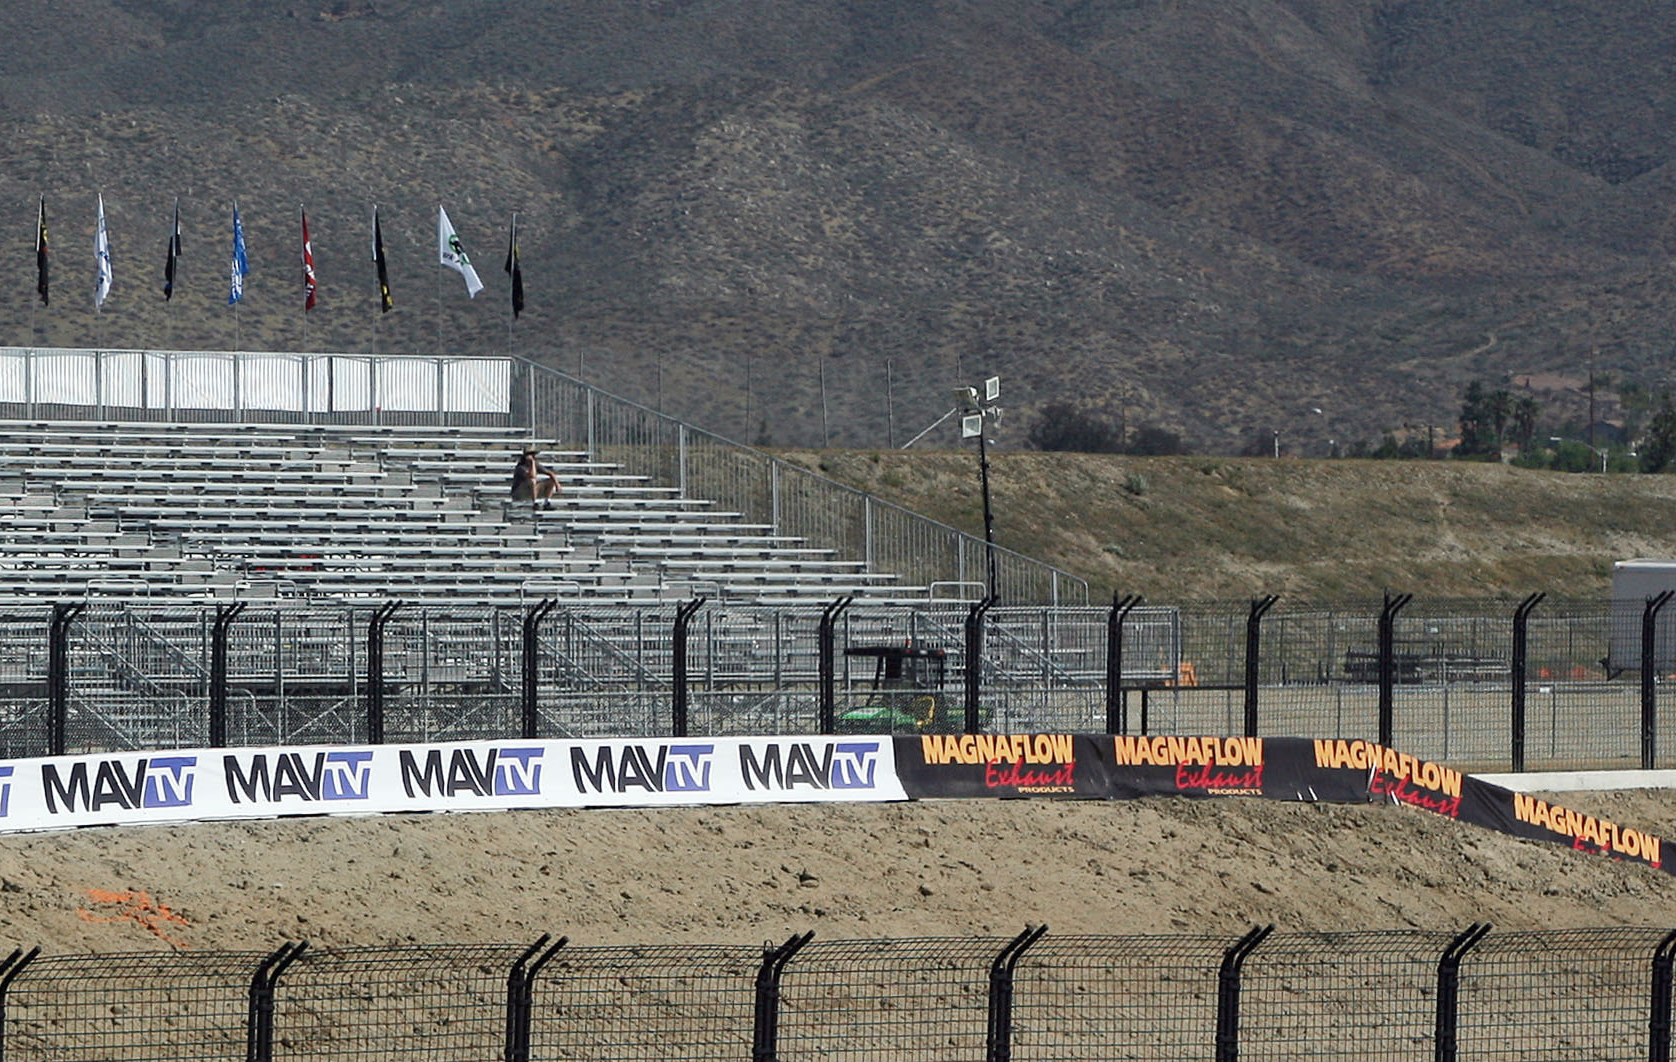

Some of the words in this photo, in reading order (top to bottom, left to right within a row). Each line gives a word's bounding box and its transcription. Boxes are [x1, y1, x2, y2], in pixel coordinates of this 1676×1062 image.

[399, 747, 545, 798] MAVTV
[570, 744, 715, 794] MAVTV
[739, 742, 879, 792] MAVTV
[922, 734, 1074, 766] MAGNAFLOW
[985, 758, 1074, 788] Exhaust
[1114, 736, 1264, 767] MAGNAFLOW
[1176, 760, 1264, 789] Exhaust
[1314, 739, 1463, 798] MAGNAFLOW
[41, 757, 197, 815] MAVTV
[223, 751, 374, 804] MAVTV
[1018, 786, 1075, 794] PRODUCTS
[1208, 788, 1263, 796] PRODUCTS
[1514, 792, 1663, 863] MAGNAFLOW
